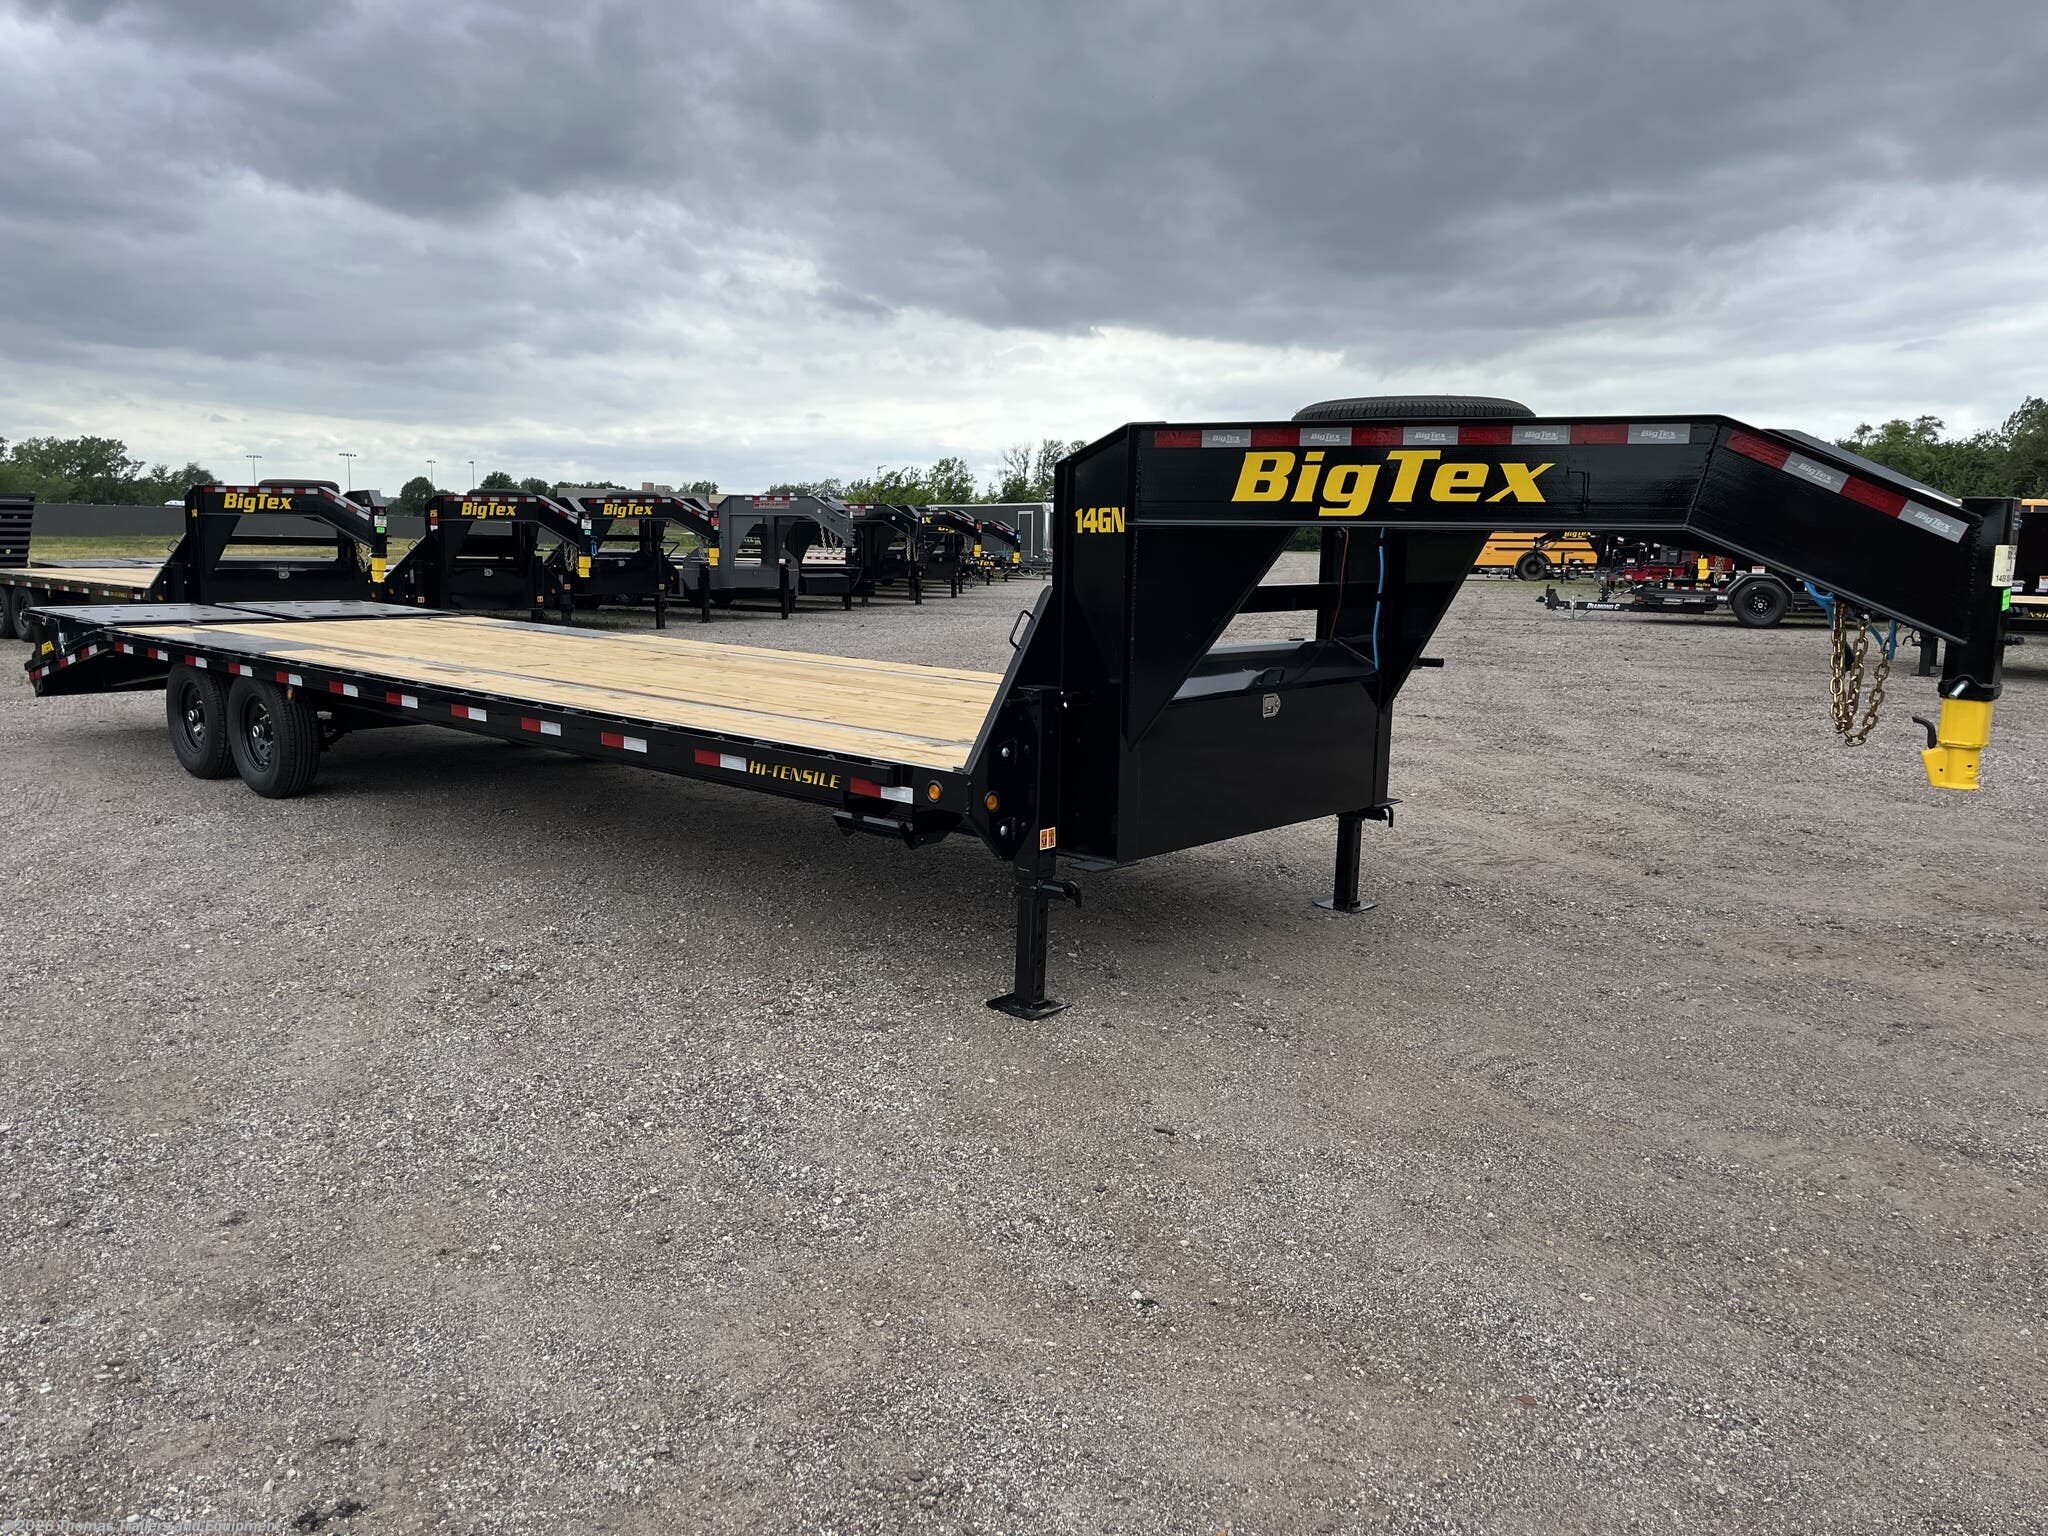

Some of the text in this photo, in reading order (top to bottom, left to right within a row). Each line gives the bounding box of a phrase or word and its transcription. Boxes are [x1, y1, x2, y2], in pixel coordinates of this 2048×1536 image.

[1231, 450, 1556, 517] BigTex
[223, 493, 293, 513] BigTex
[461, 502, 517, 519] BigTex
[602, 503, 654, 519] BigTex
[1075, 507, 1125, 533] 14GN
[749, 760, 841, 789] HI-TENSILE
